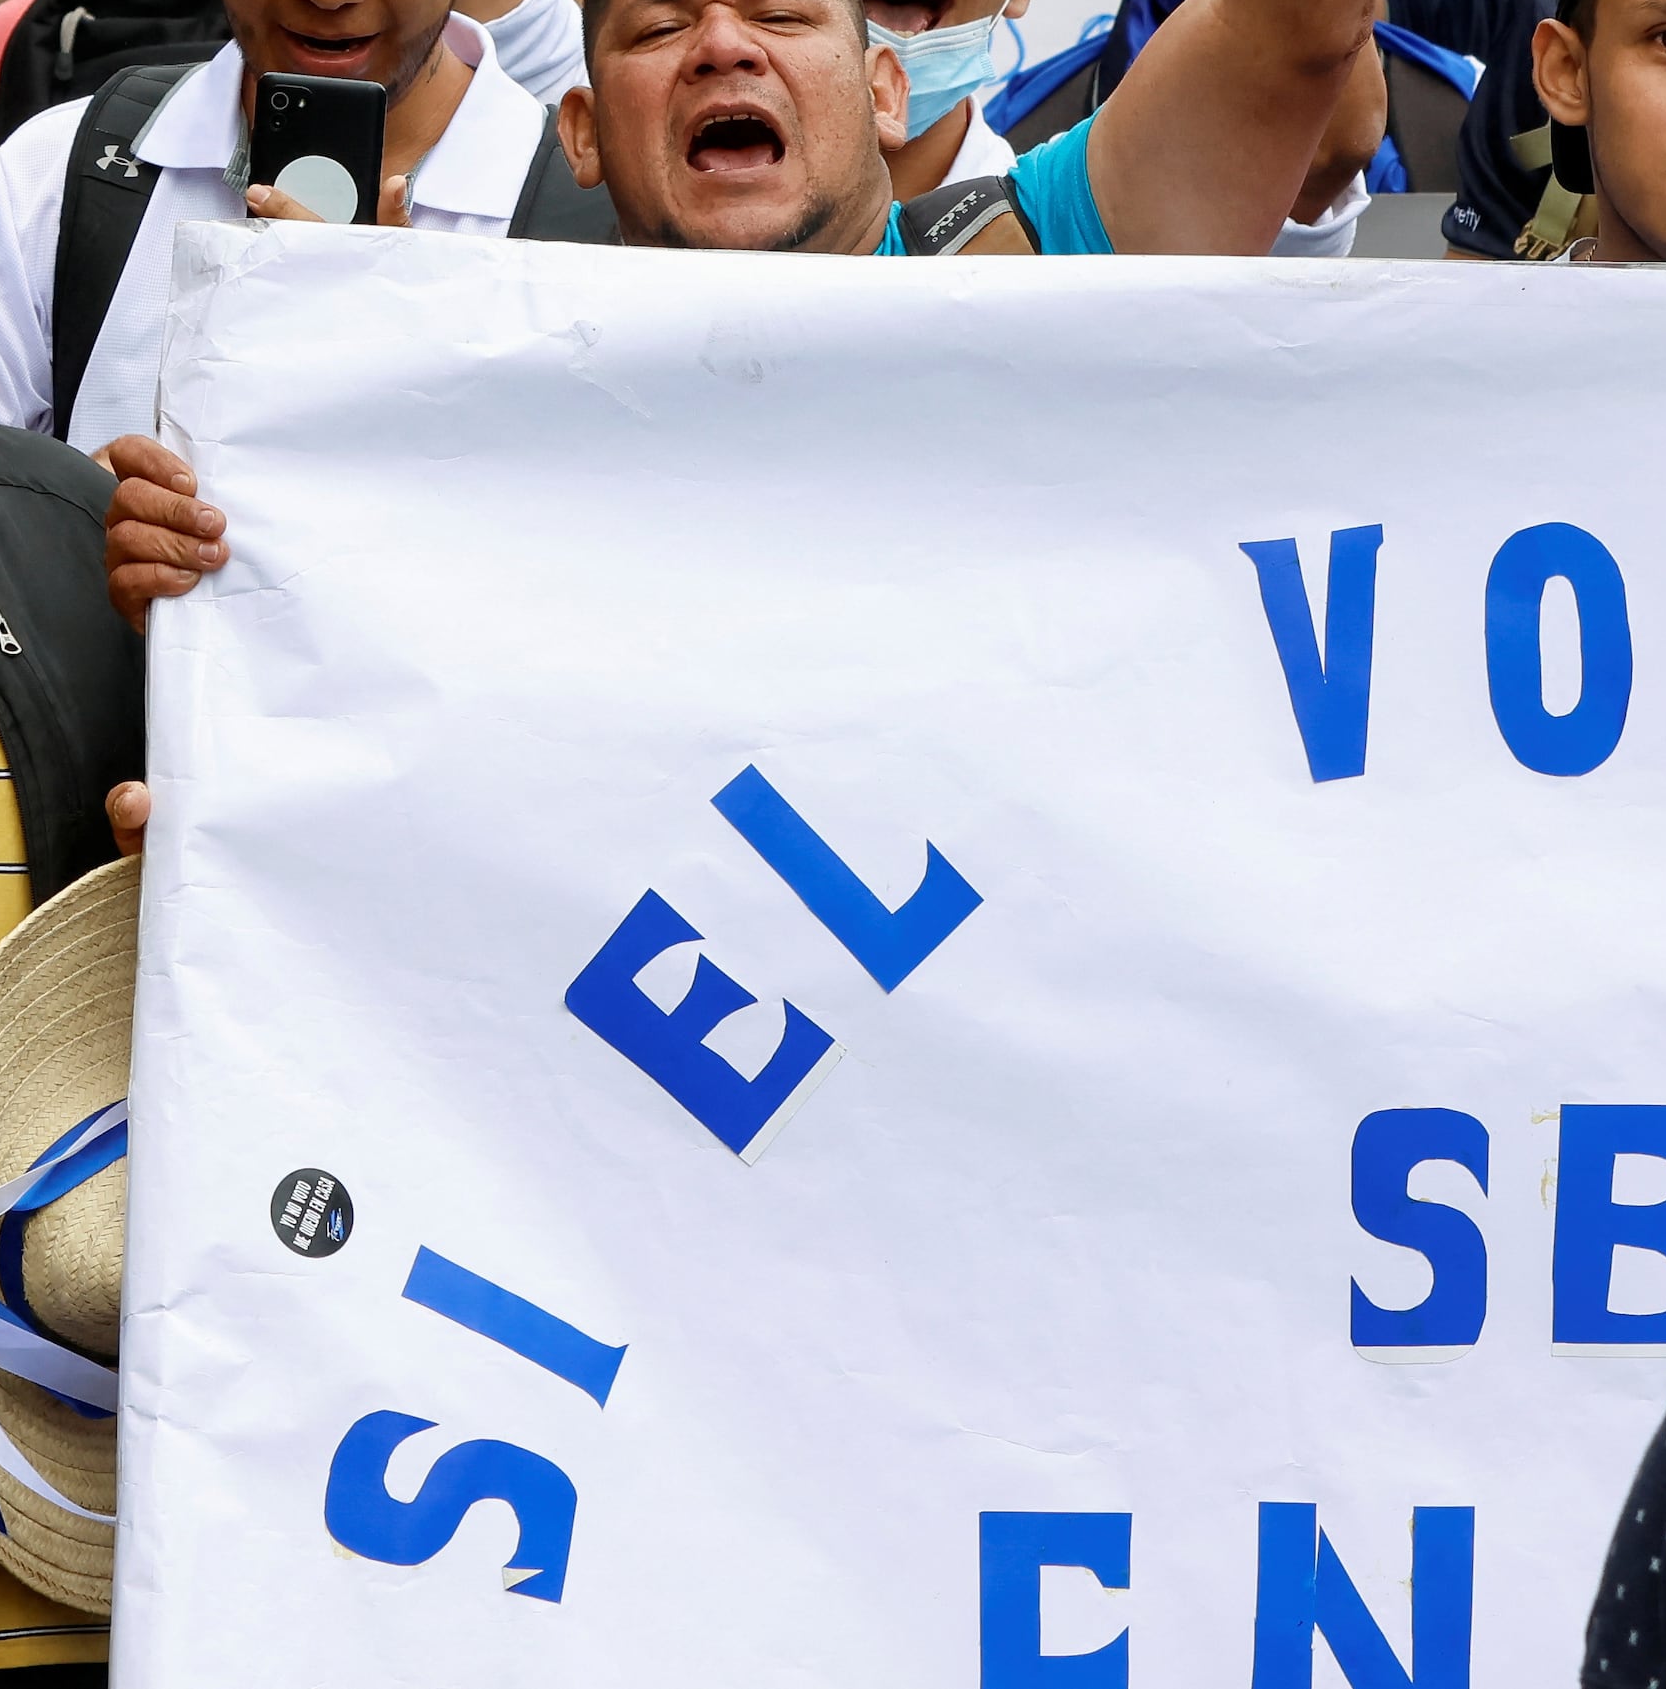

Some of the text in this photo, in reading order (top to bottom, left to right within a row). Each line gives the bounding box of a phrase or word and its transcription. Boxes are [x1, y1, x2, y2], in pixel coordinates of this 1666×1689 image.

[565, 763, 985, 1162] EL
[279, 1180, 312, 1229] YO NO VOTO
[293, 1176, 335, 1250] ME QUEDO EN CASA
[324, 1243, 630, 1604] SI
